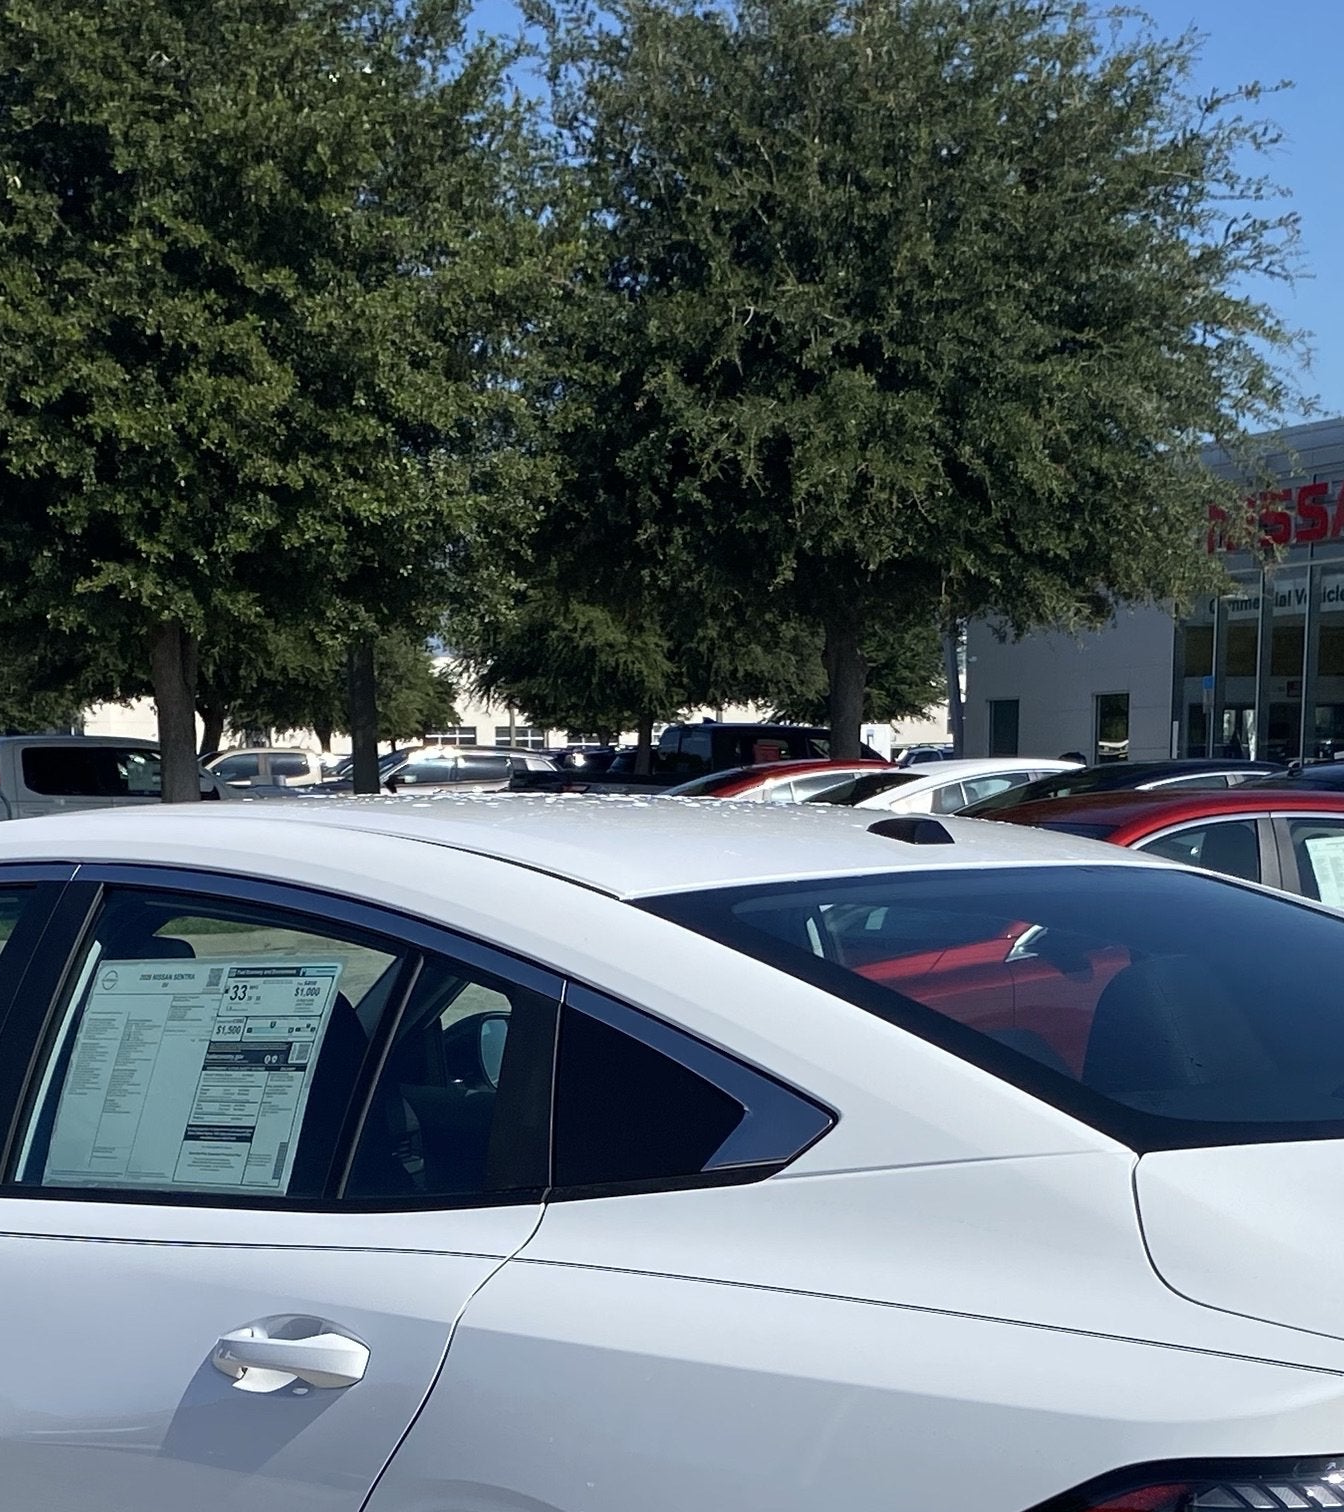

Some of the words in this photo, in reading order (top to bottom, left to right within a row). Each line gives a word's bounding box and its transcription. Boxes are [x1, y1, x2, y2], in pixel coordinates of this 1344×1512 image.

[229, 985, 248, 1001] 33
[294, 987, 321, 997] $1,000
[216, 1025, 242, 1036] $1,500
